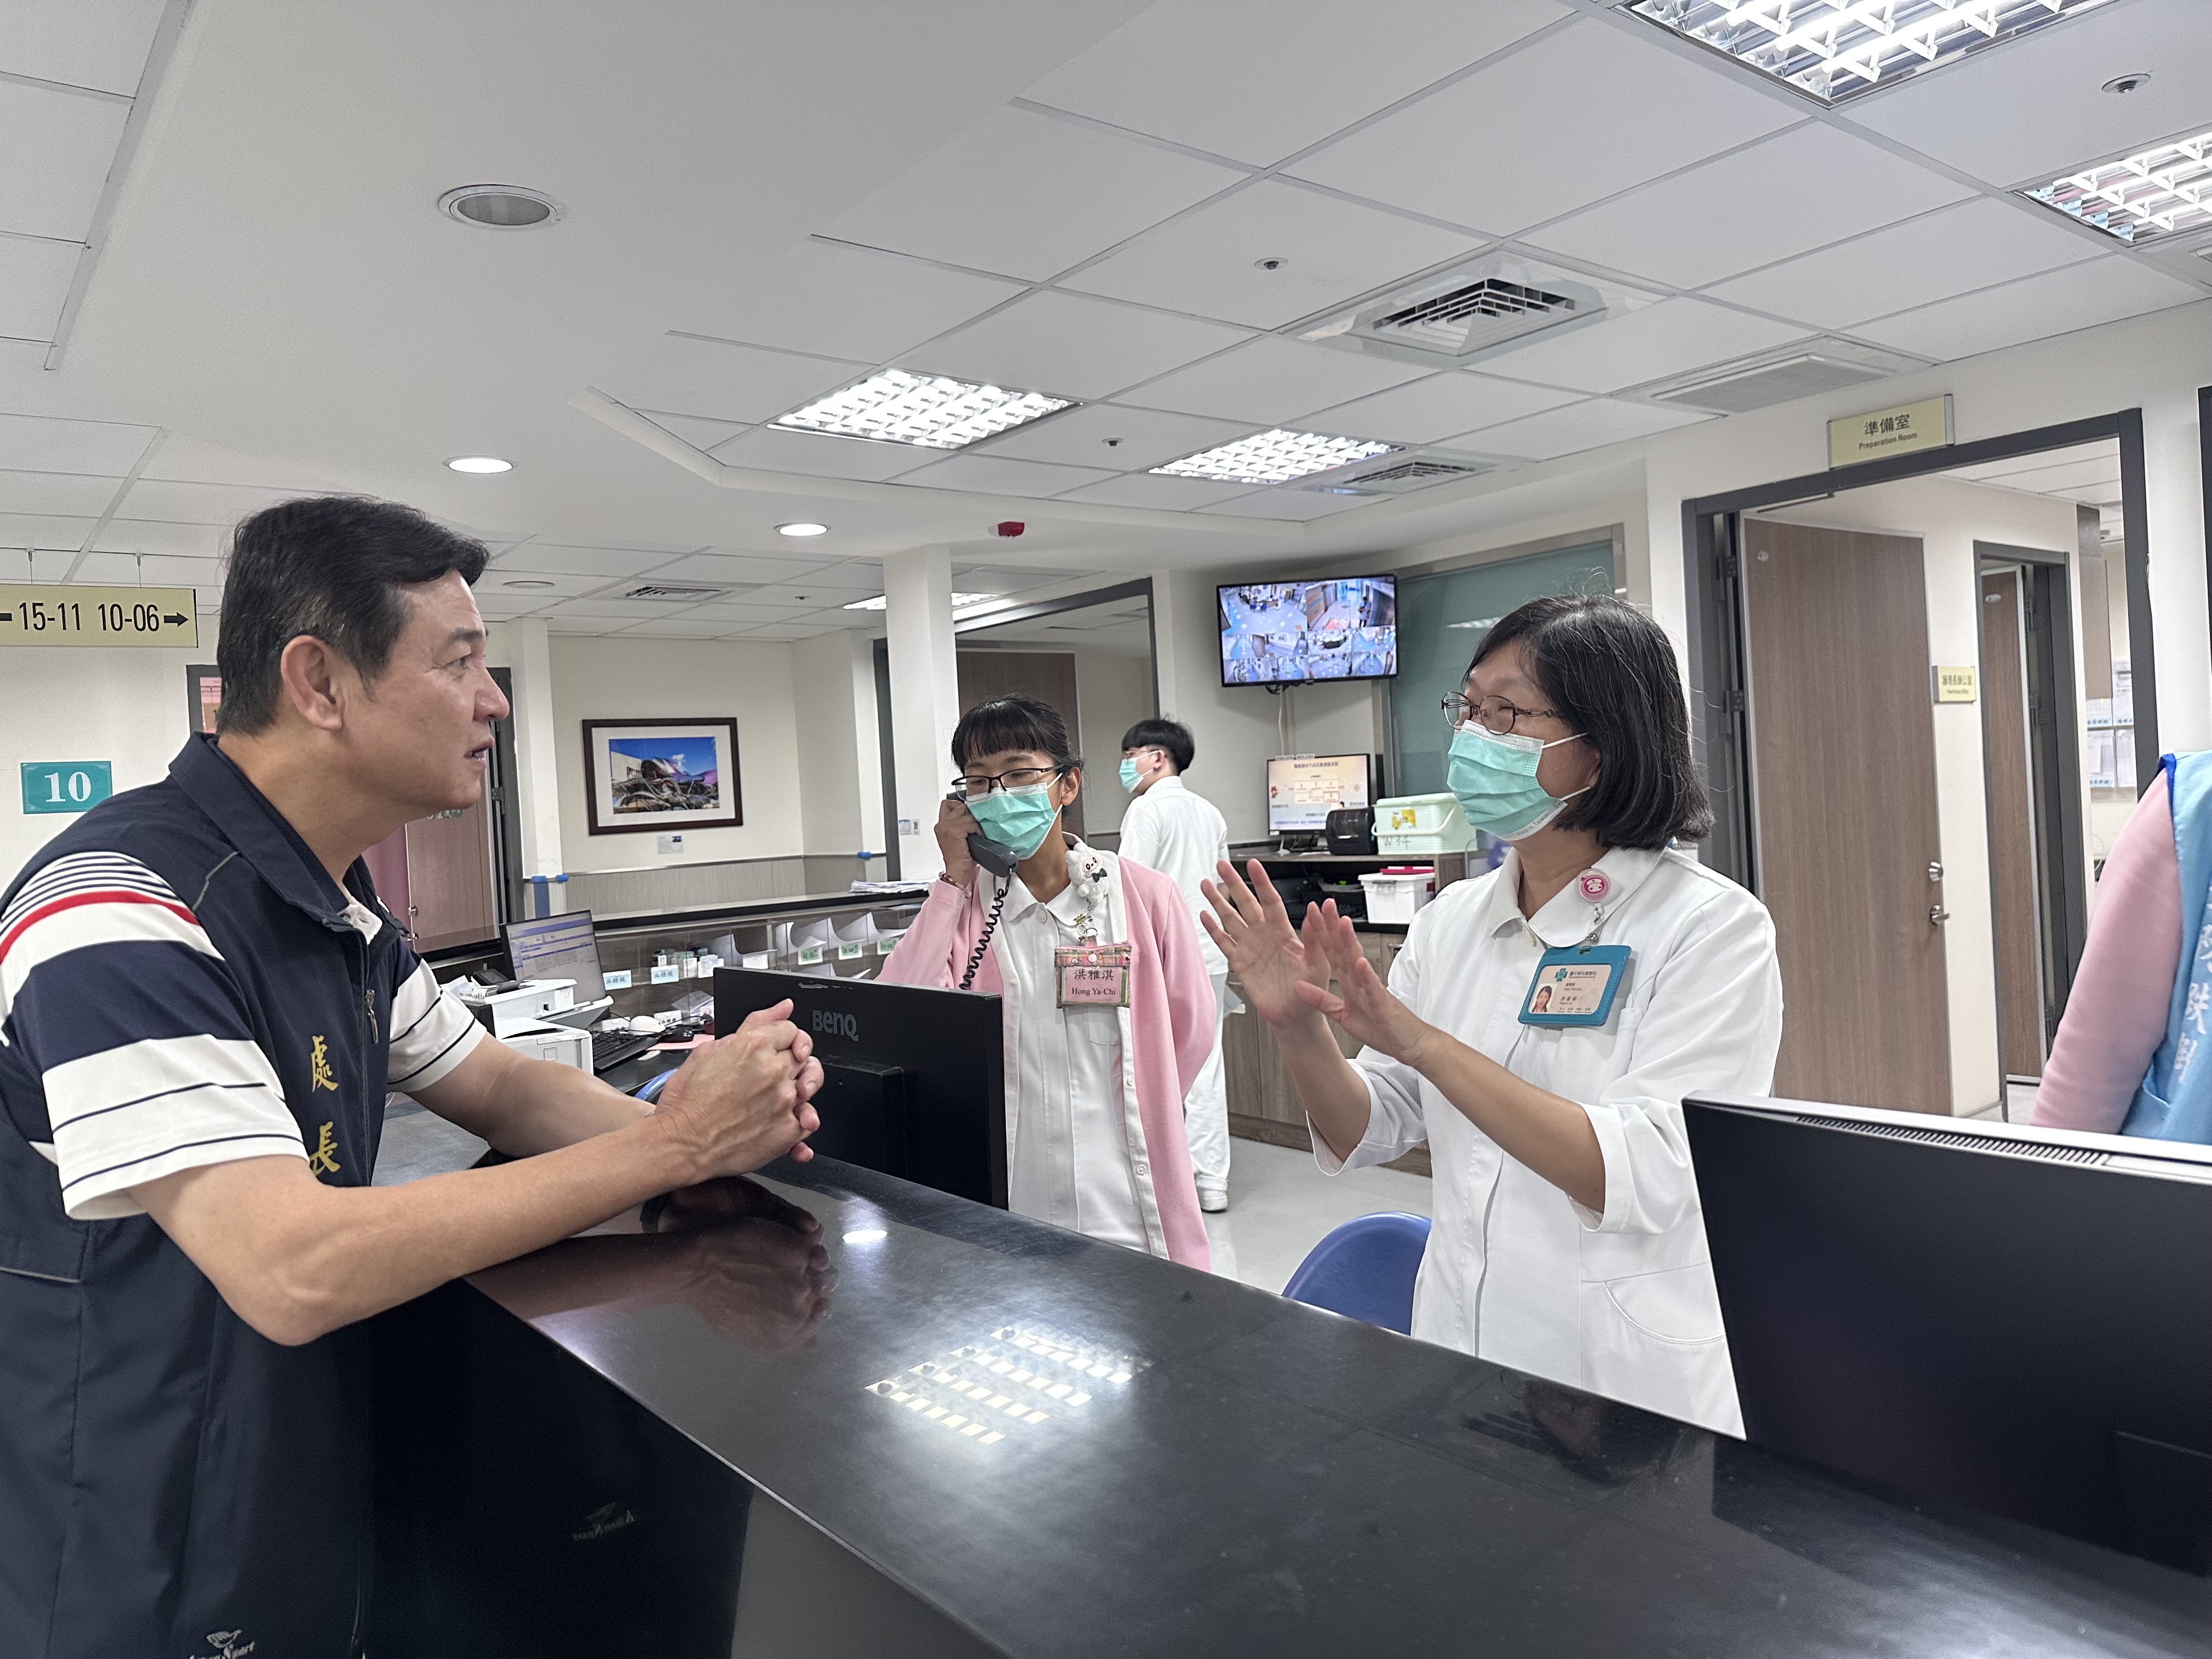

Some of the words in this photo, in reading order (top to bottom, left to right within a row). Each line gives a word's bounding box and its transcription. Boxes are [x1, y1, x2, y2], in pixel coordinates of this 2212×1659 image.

[1864, 414, 1910, 436] 準備室
[1859, 437, 1897, 450] Preparation
[1898, 432, 1917, 442] Room
[19, 602, 81, 630] 15-11
[98, 603, 160, 631] 10-06
[44, 771, 91, 802] 10
[1532, 812, 1550, 826] Taiwan
[1074, 969, 1114, 981] 洪雅淇
[812, 1009, 859, 1041] BenQ
[309, 1035, 341, 1176] 處長
